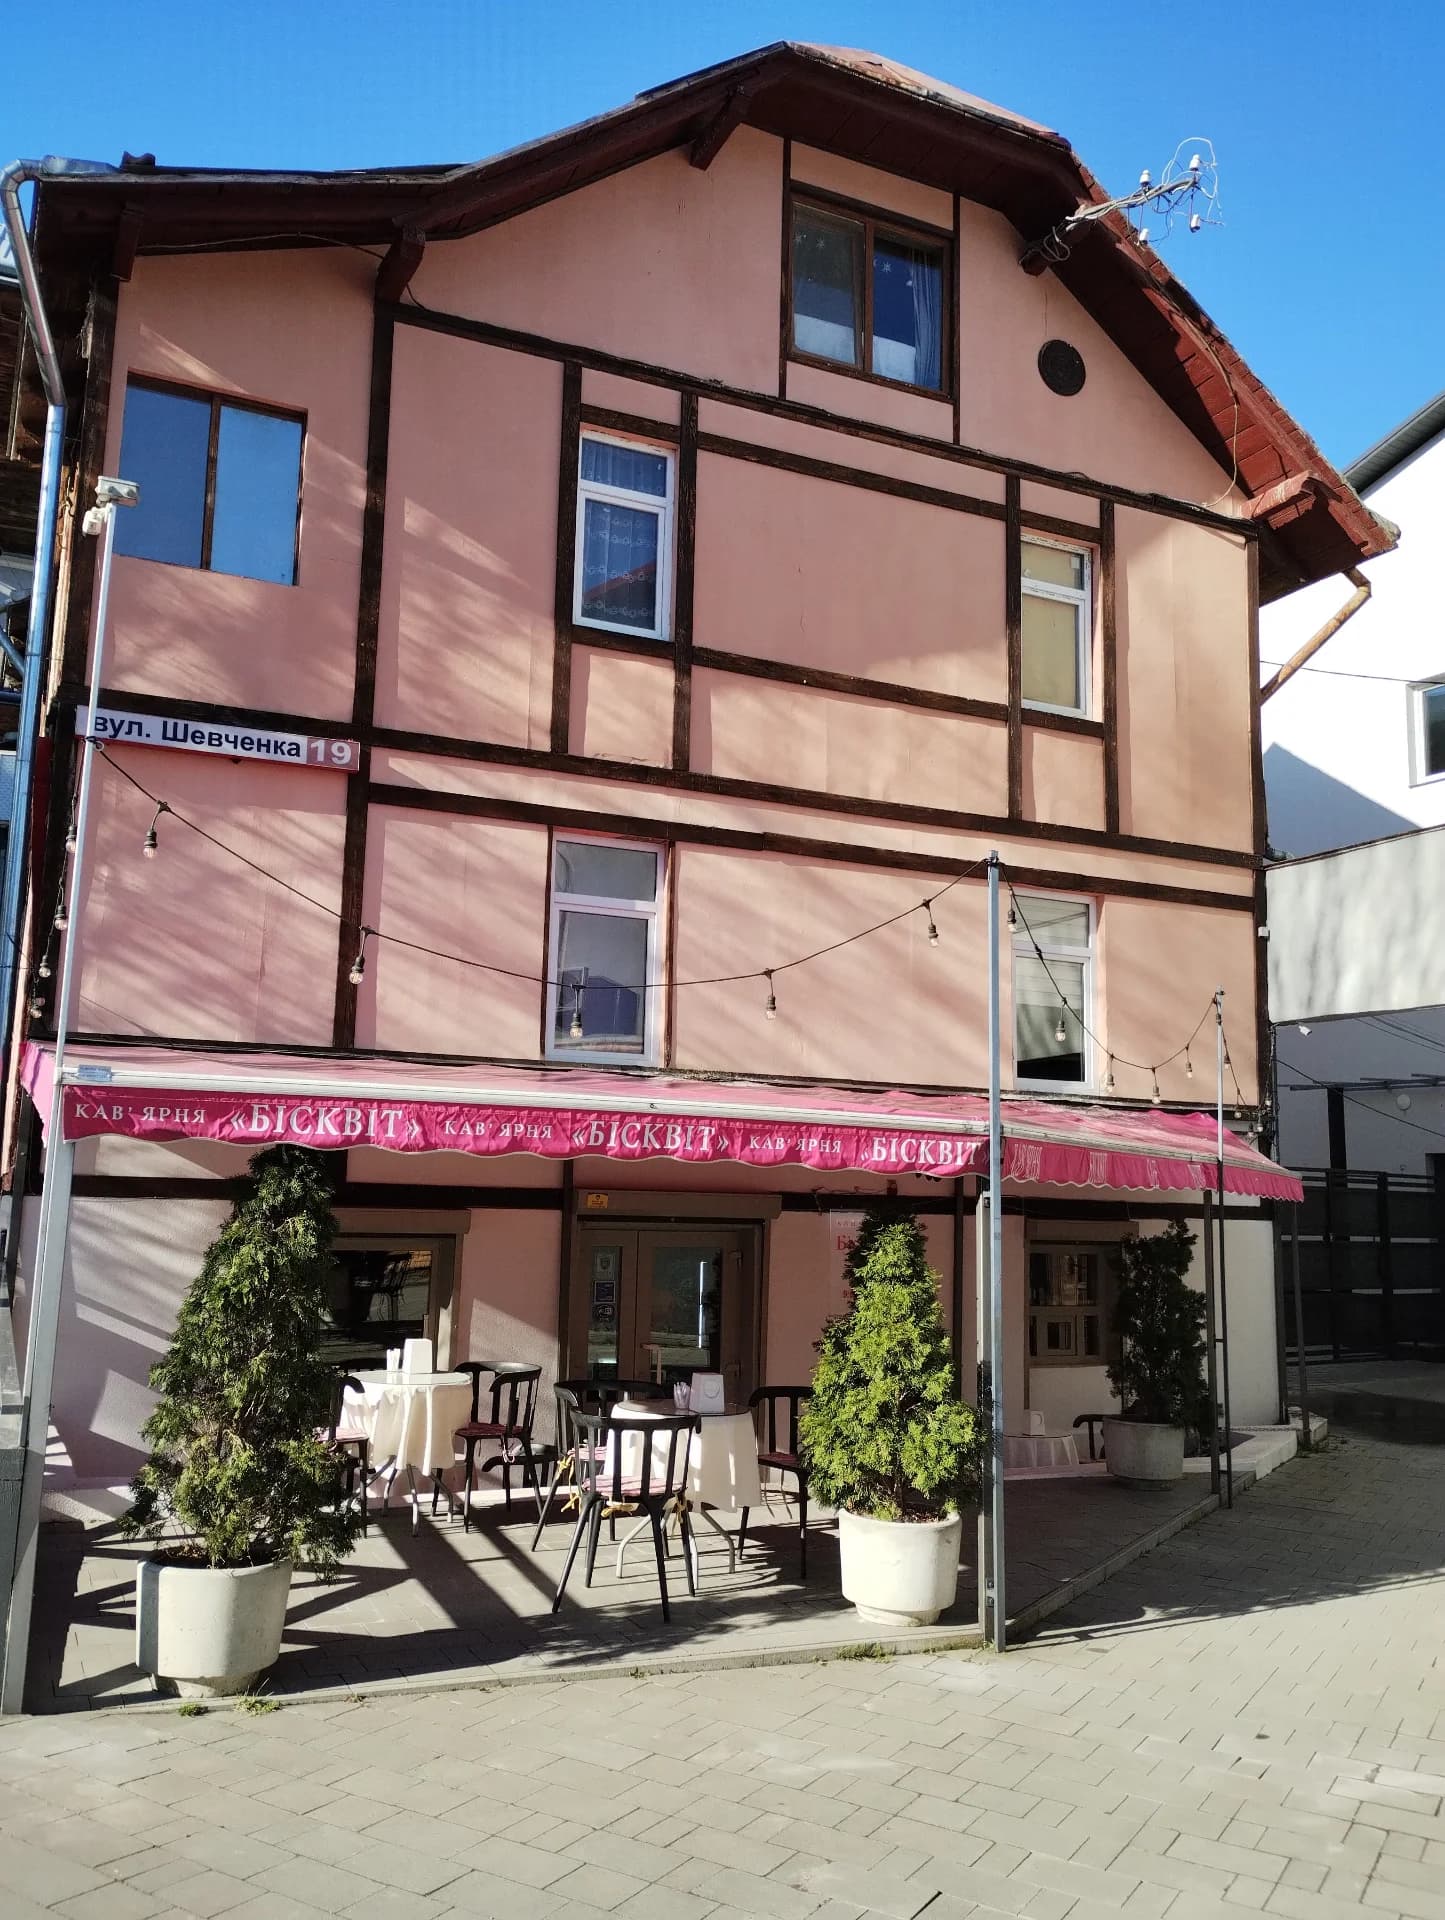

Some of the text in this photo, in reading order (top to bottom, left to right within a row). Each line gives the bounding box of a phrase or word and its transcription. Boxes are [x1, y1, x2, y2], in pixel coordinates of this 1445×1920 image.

[94, 716, 352, 765] вул. Шевченка 19
[230, 1104, 420, 1140] «БІСКВІТ»
[572, 1120, 730, 1152] «БІСКВІТ»
